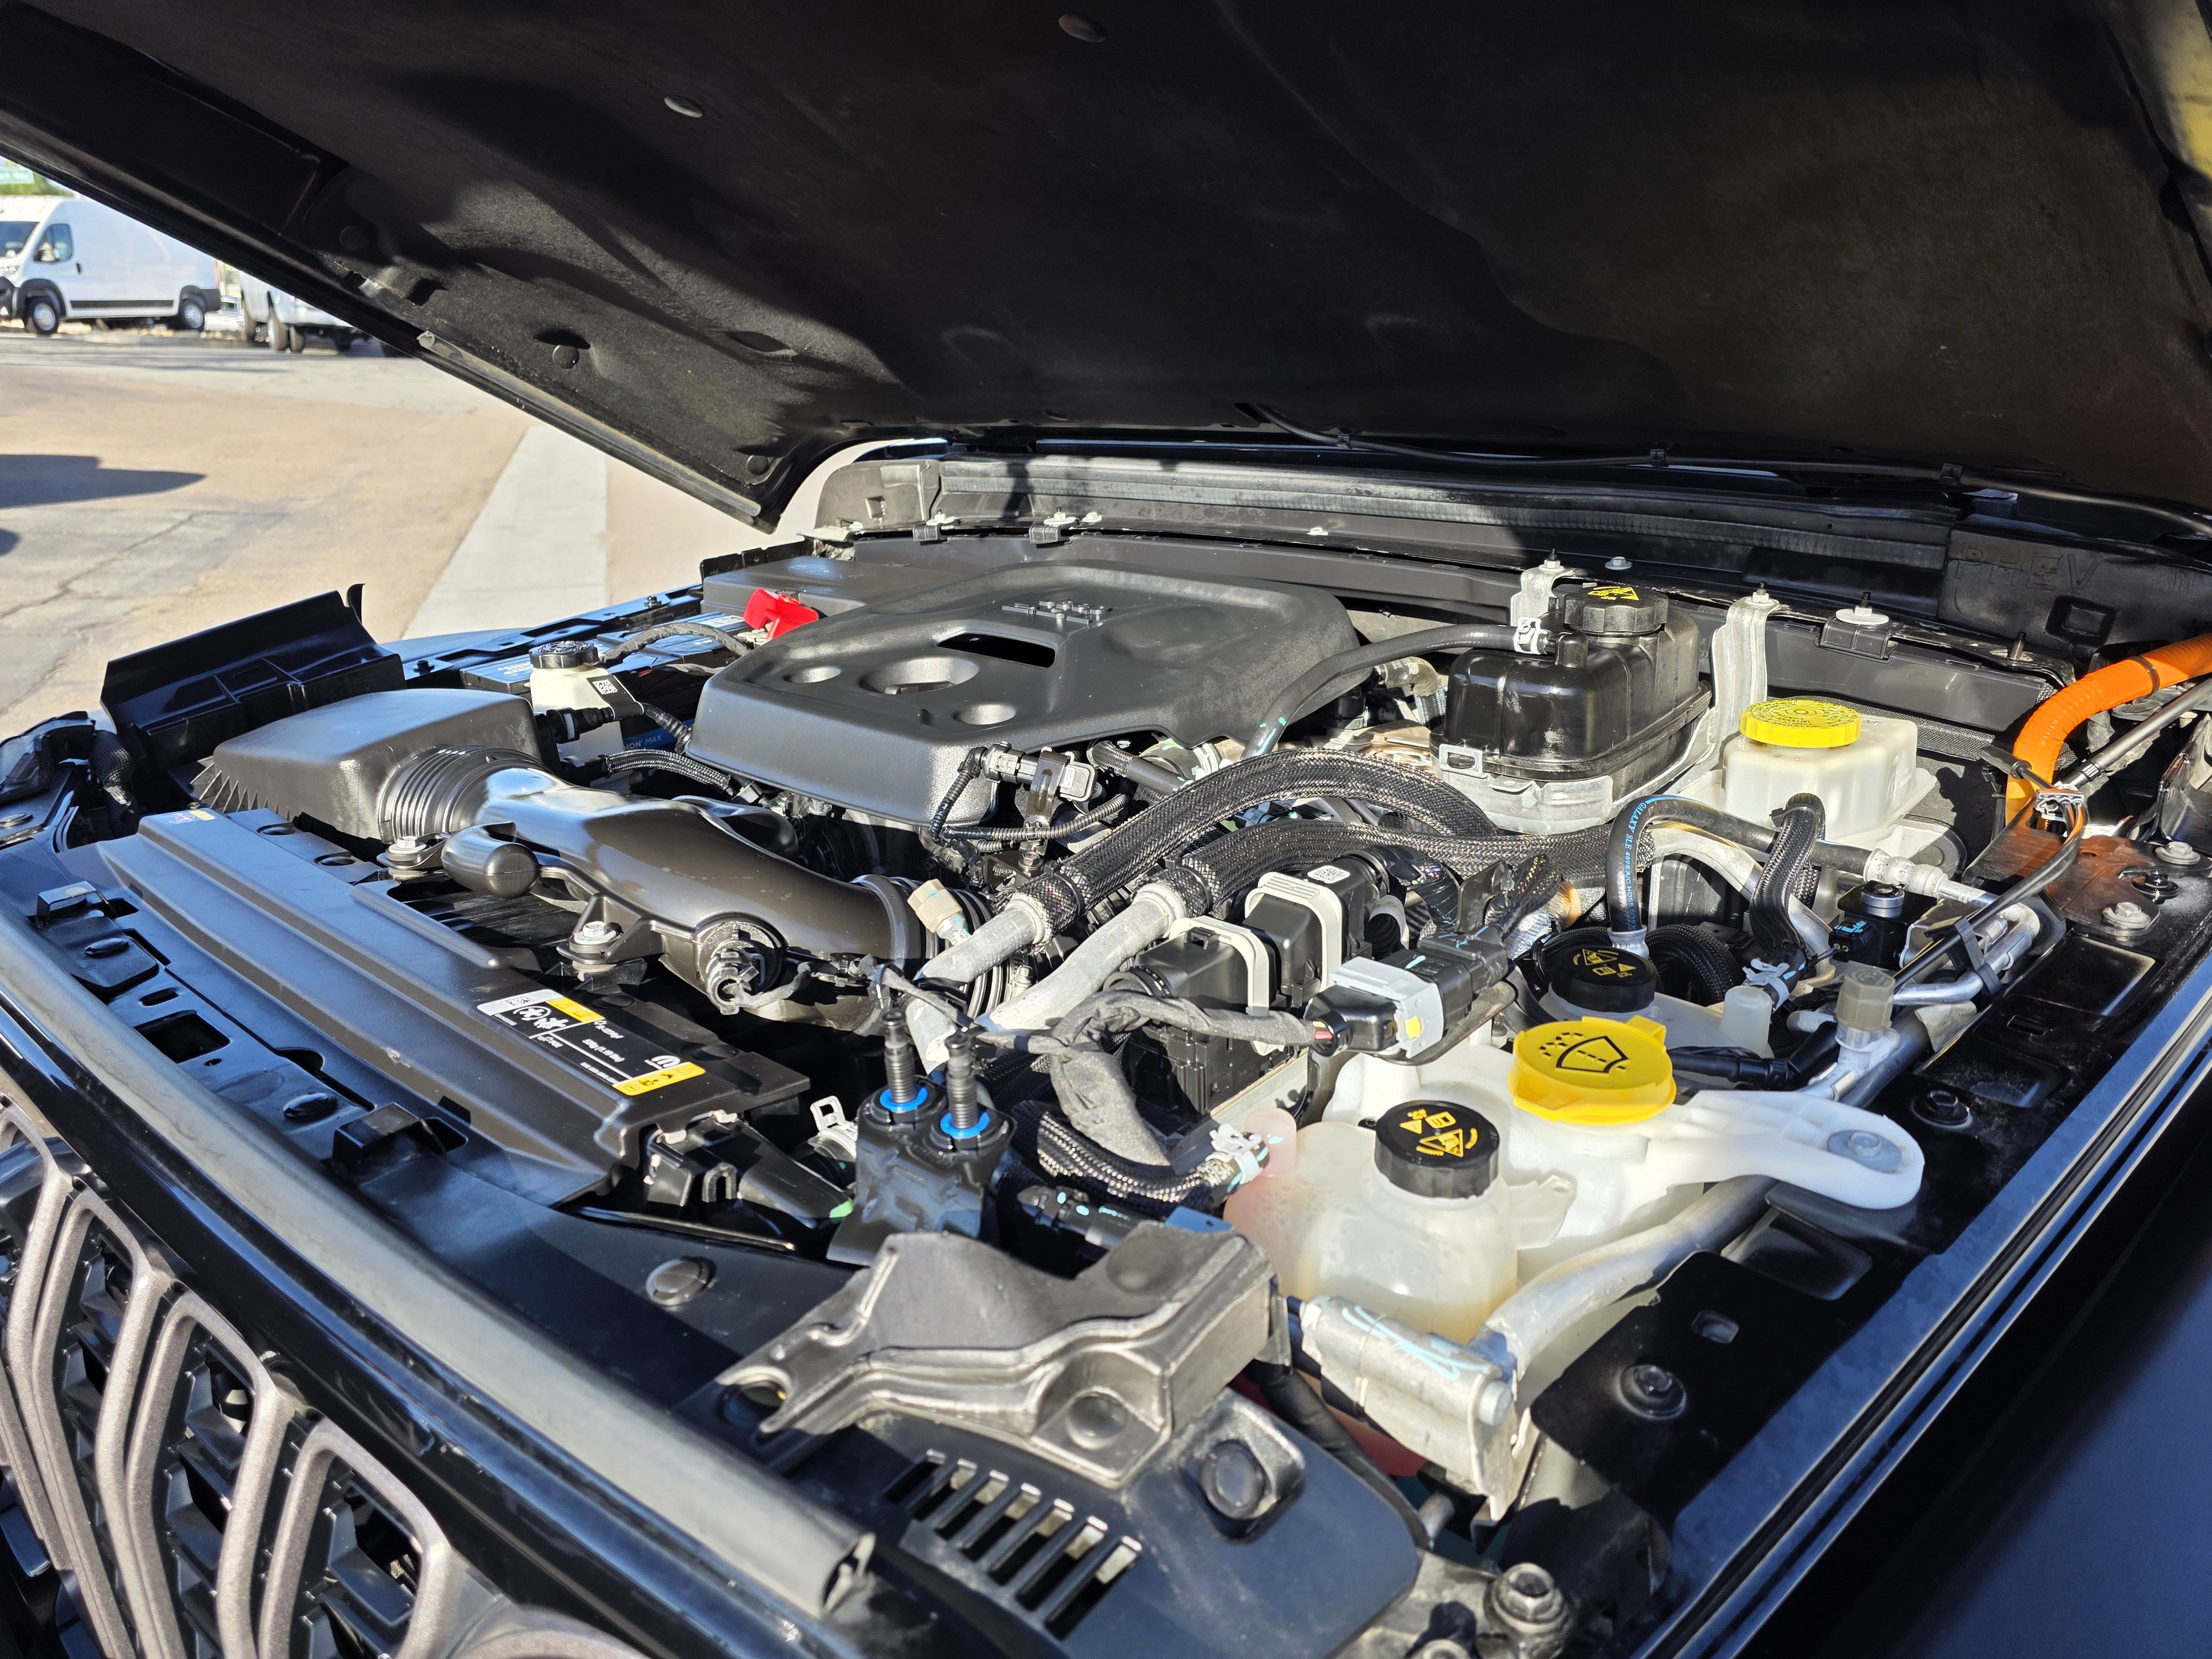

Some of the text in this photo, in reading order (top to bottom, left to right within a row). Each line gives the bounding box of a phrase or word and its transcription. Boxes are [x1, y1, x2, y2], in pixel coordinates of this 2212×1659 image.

[645, 734, 662, 744] MAX
[1628, 802, 1647, 833] GALAXY
[1625, 833, 1634, 849] SLE
